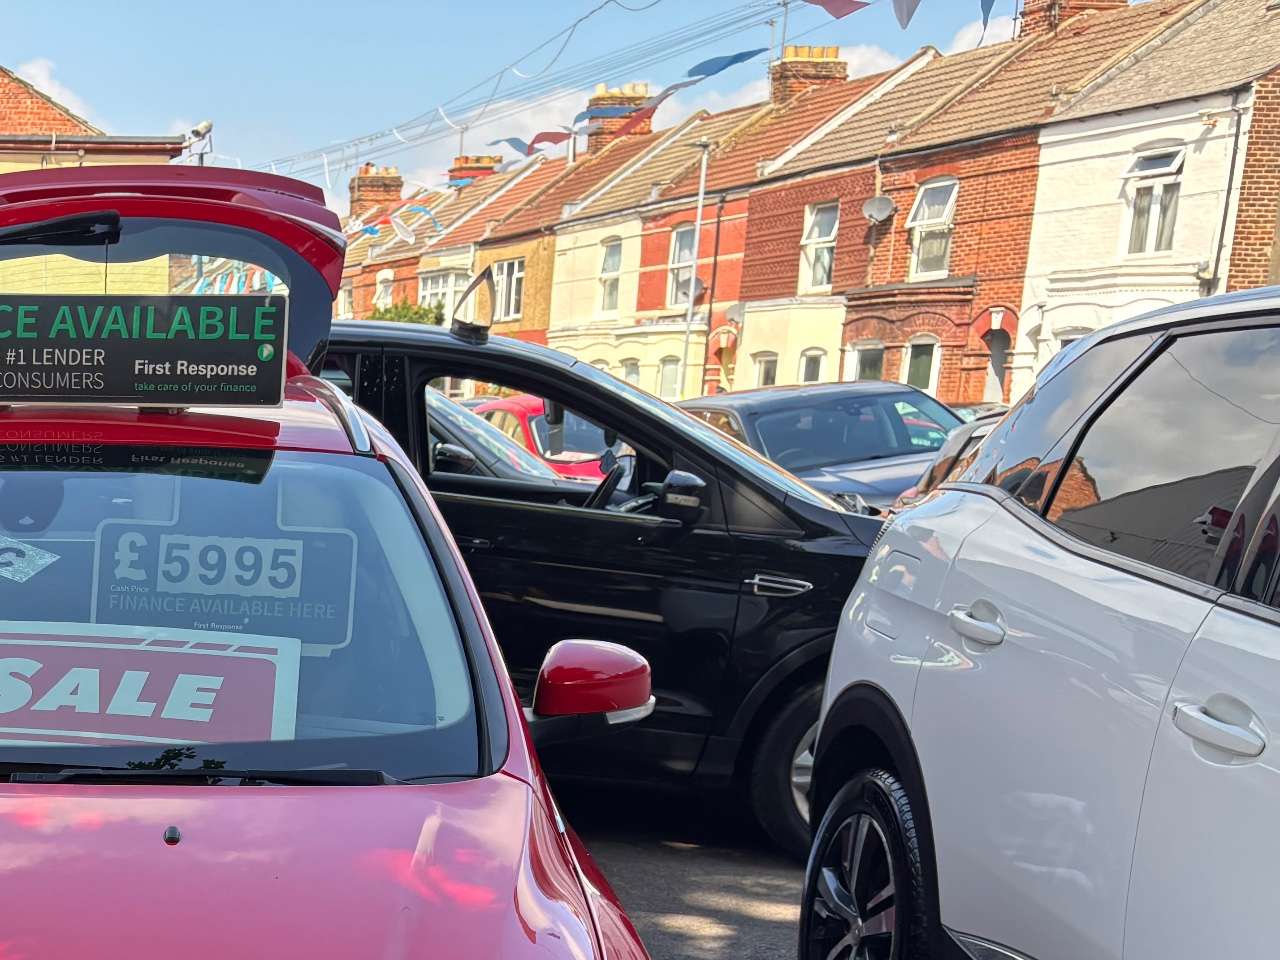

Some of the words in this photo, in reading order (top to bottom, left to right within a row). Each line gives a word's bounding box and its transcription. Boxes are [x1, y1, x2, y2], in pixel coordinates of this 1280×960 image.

[49, 305, 277, 341] AVAILABLE
[6, 348, 26, 366] #1
[33, 349, 104, 367] LENDER
[135, 359, 170, 375] First
[177, 359, 257, 378] Response
[135, 382, 154, 392] take
[157, 383, 179, 392] care
[181, 382, 192, 392] of
[194, 383, 216, 394] your
[220, 382, 257, 393] finance
[114, 531, 297, 590] £5995
[109, 595, 185, 612] FINANCE
[190, 599, 284, 617] AVAILABLE
[289, 603, 336, 619] HERE
